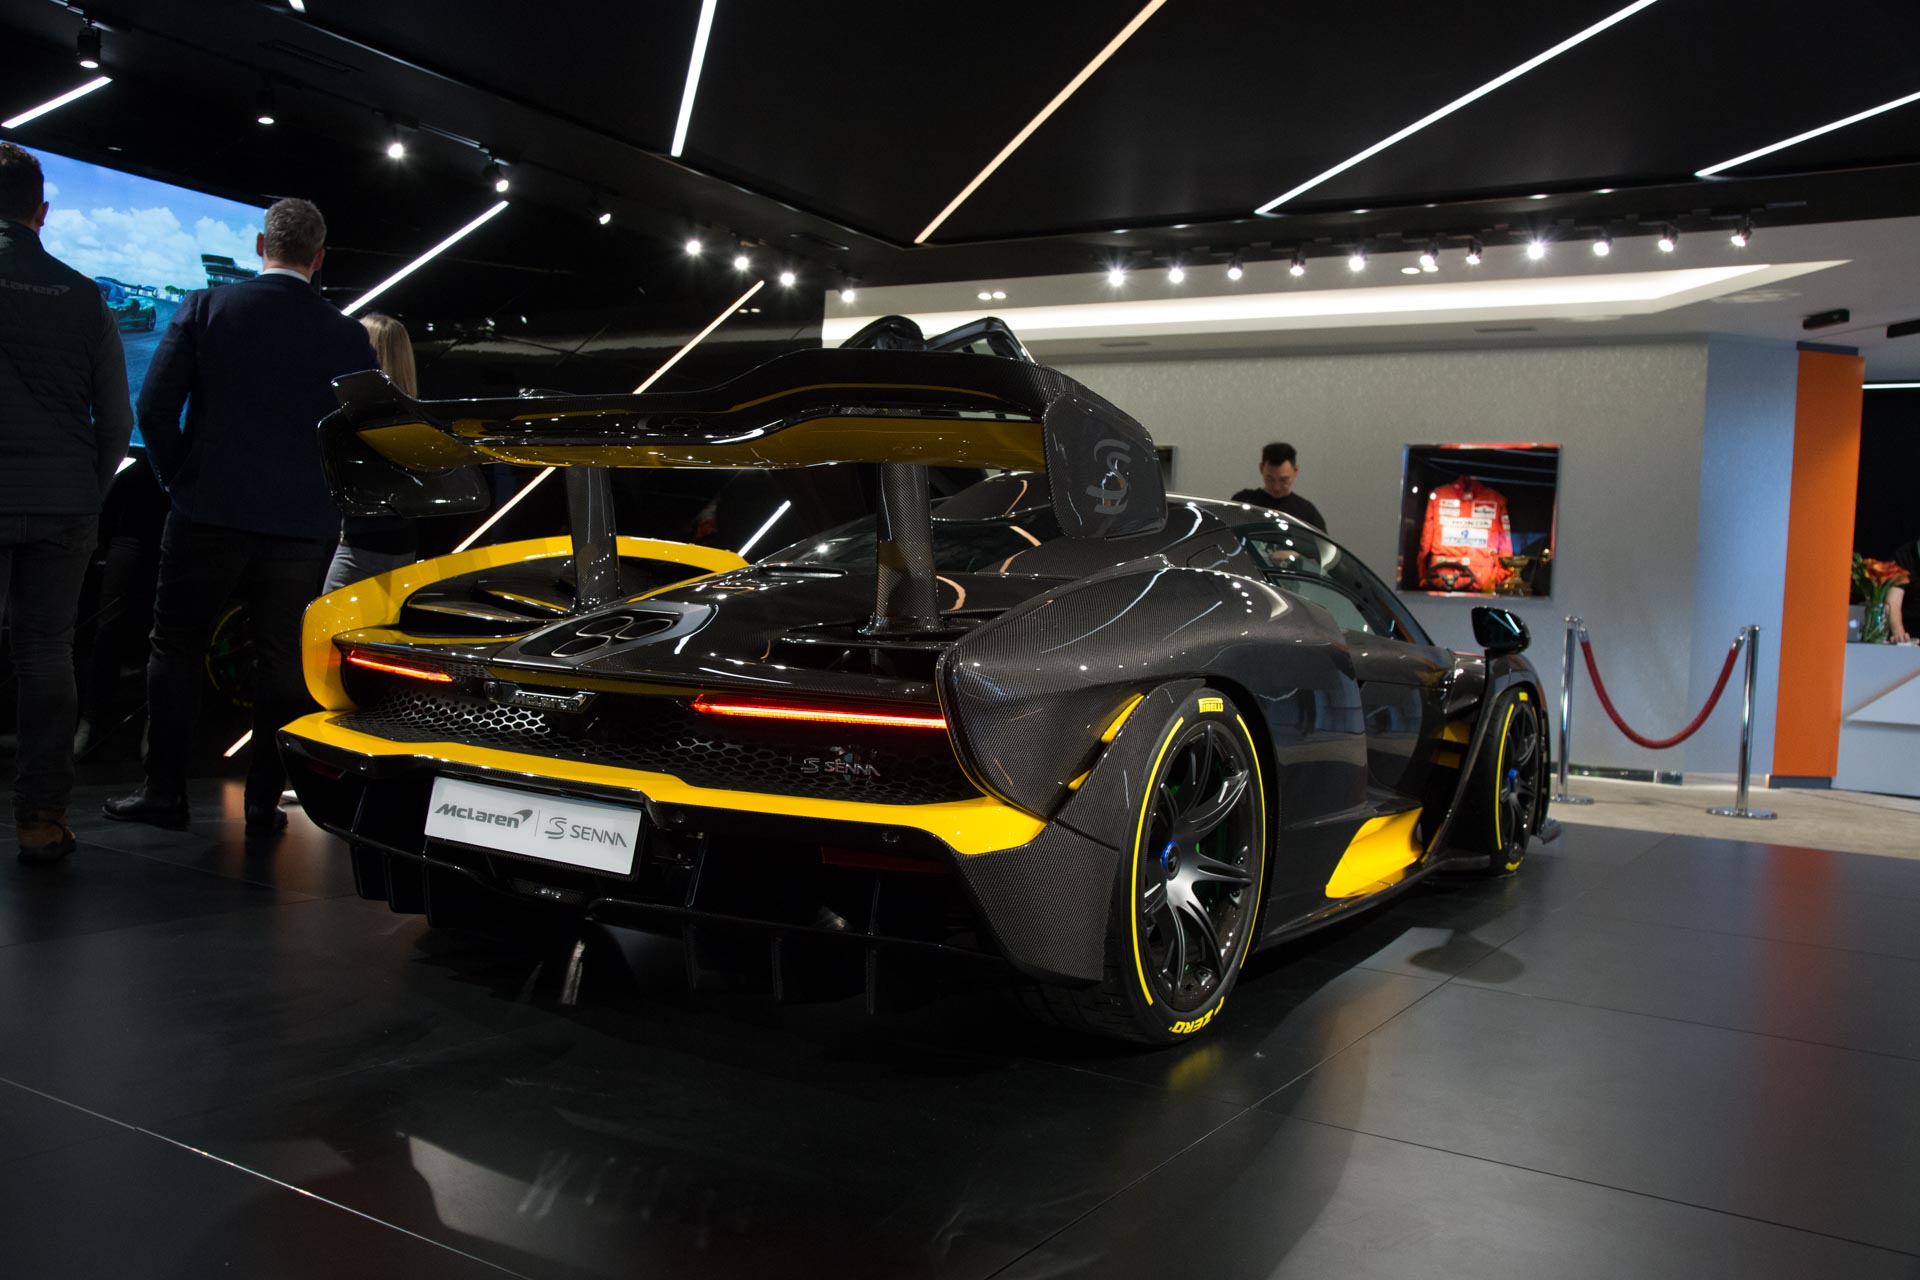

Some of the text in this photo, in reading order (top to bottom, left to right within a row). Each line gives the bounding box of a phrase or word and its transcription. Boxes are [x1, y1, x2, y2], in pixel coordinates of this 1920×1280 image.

[1198, 697, 1224, 713] PIRELLI
[434, 803, 521, 829] McLaren
[570, 824, 628, 848] SENNA
[1171, 1009, 1214, 1034] ZERO
